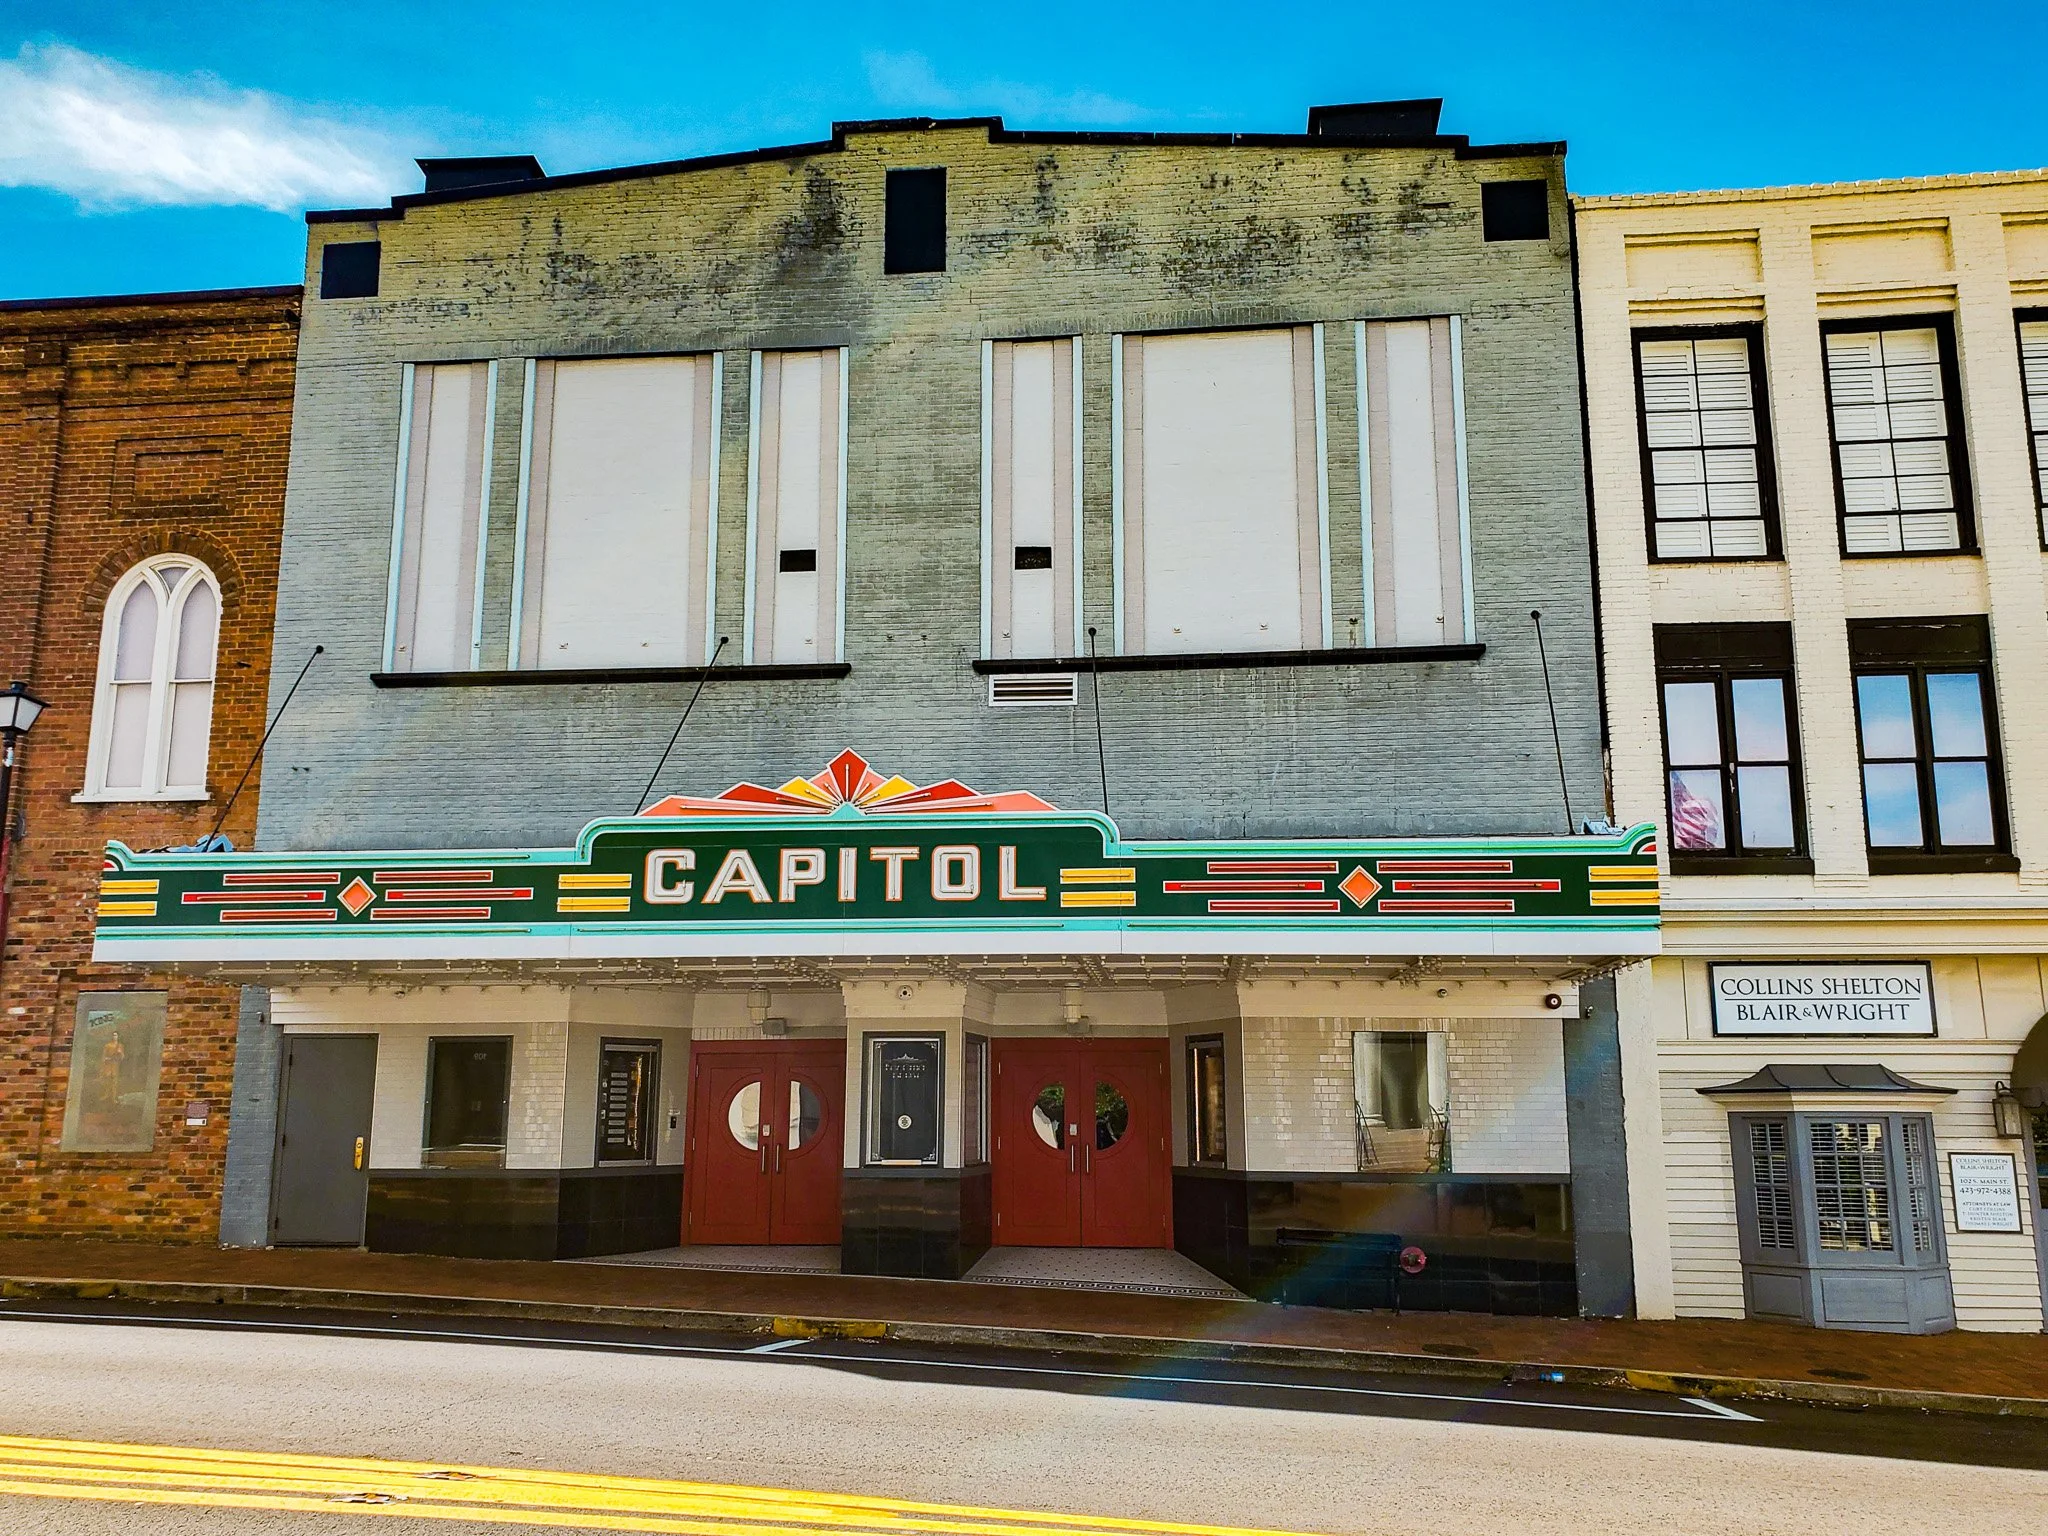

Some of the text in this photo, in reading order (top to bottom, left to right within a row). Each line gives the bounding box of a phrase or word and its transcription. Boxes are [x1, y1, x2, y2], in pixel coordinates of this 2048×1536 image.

[644, 845, 1047, 904] CAPITOL
[1720, 977, 1921, 995] COLLINS SHELTON
[1960, 1187, 2012, 1195] 423-972-4388
